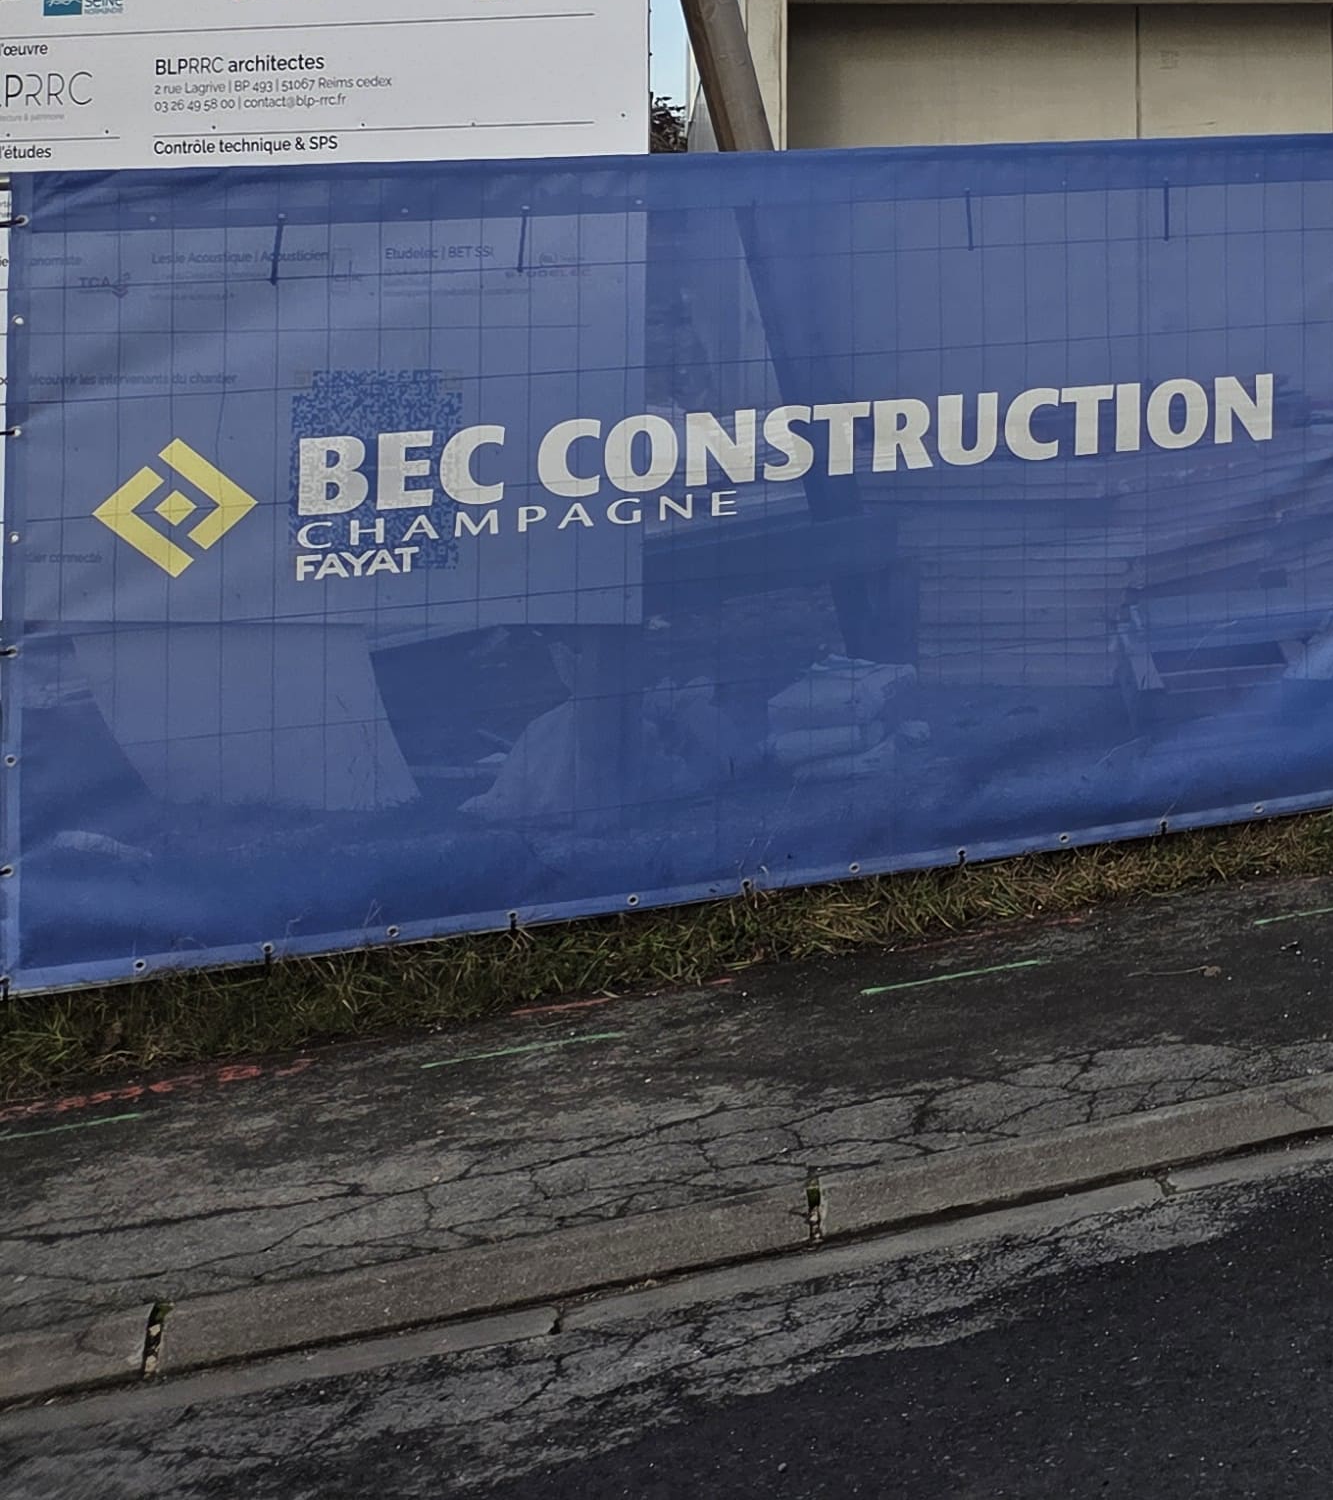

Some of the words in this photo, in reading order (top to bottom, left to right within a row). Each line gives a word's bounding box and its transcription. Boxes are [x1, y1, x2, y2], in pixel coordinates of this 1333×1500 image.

[156, 56, 224, 76] BLPRRC
[228, 54, 325, 72] architectes
[0, 71, 93, 107] PRRC
[154, 85, 161, 95] 2
[163, 84, 183, 94] rue
[185, 80, 226, 97] Lagrive
[234, 80, 250, 92] BP
[252, 81, 273, 94] 493
[281, 78, 315, 92] 51067
[318, 76, 354, 89] Reims
[356, 75, 392, 88] cedex
[154, 101, 169, 114] 03
[171, 98, 184, 111] 26
[187, 100, 201, 112] 49
[203, 98, 218, 112] 58
[221, 99, 235, 110] 00
[153, 139, 216, 155] Contrôle
[219, 136, 292, 155] technique
[295, 137, 305, 150] &
[309, 135, 338, 150] SPS
[298, 425, 506, 517] BEC
[537, 373, 1274, 498] CONSTRUCTION
[297, 490, 738, 550] CHAMPAGNE
[296, 546, 420, 582] FAYAT
